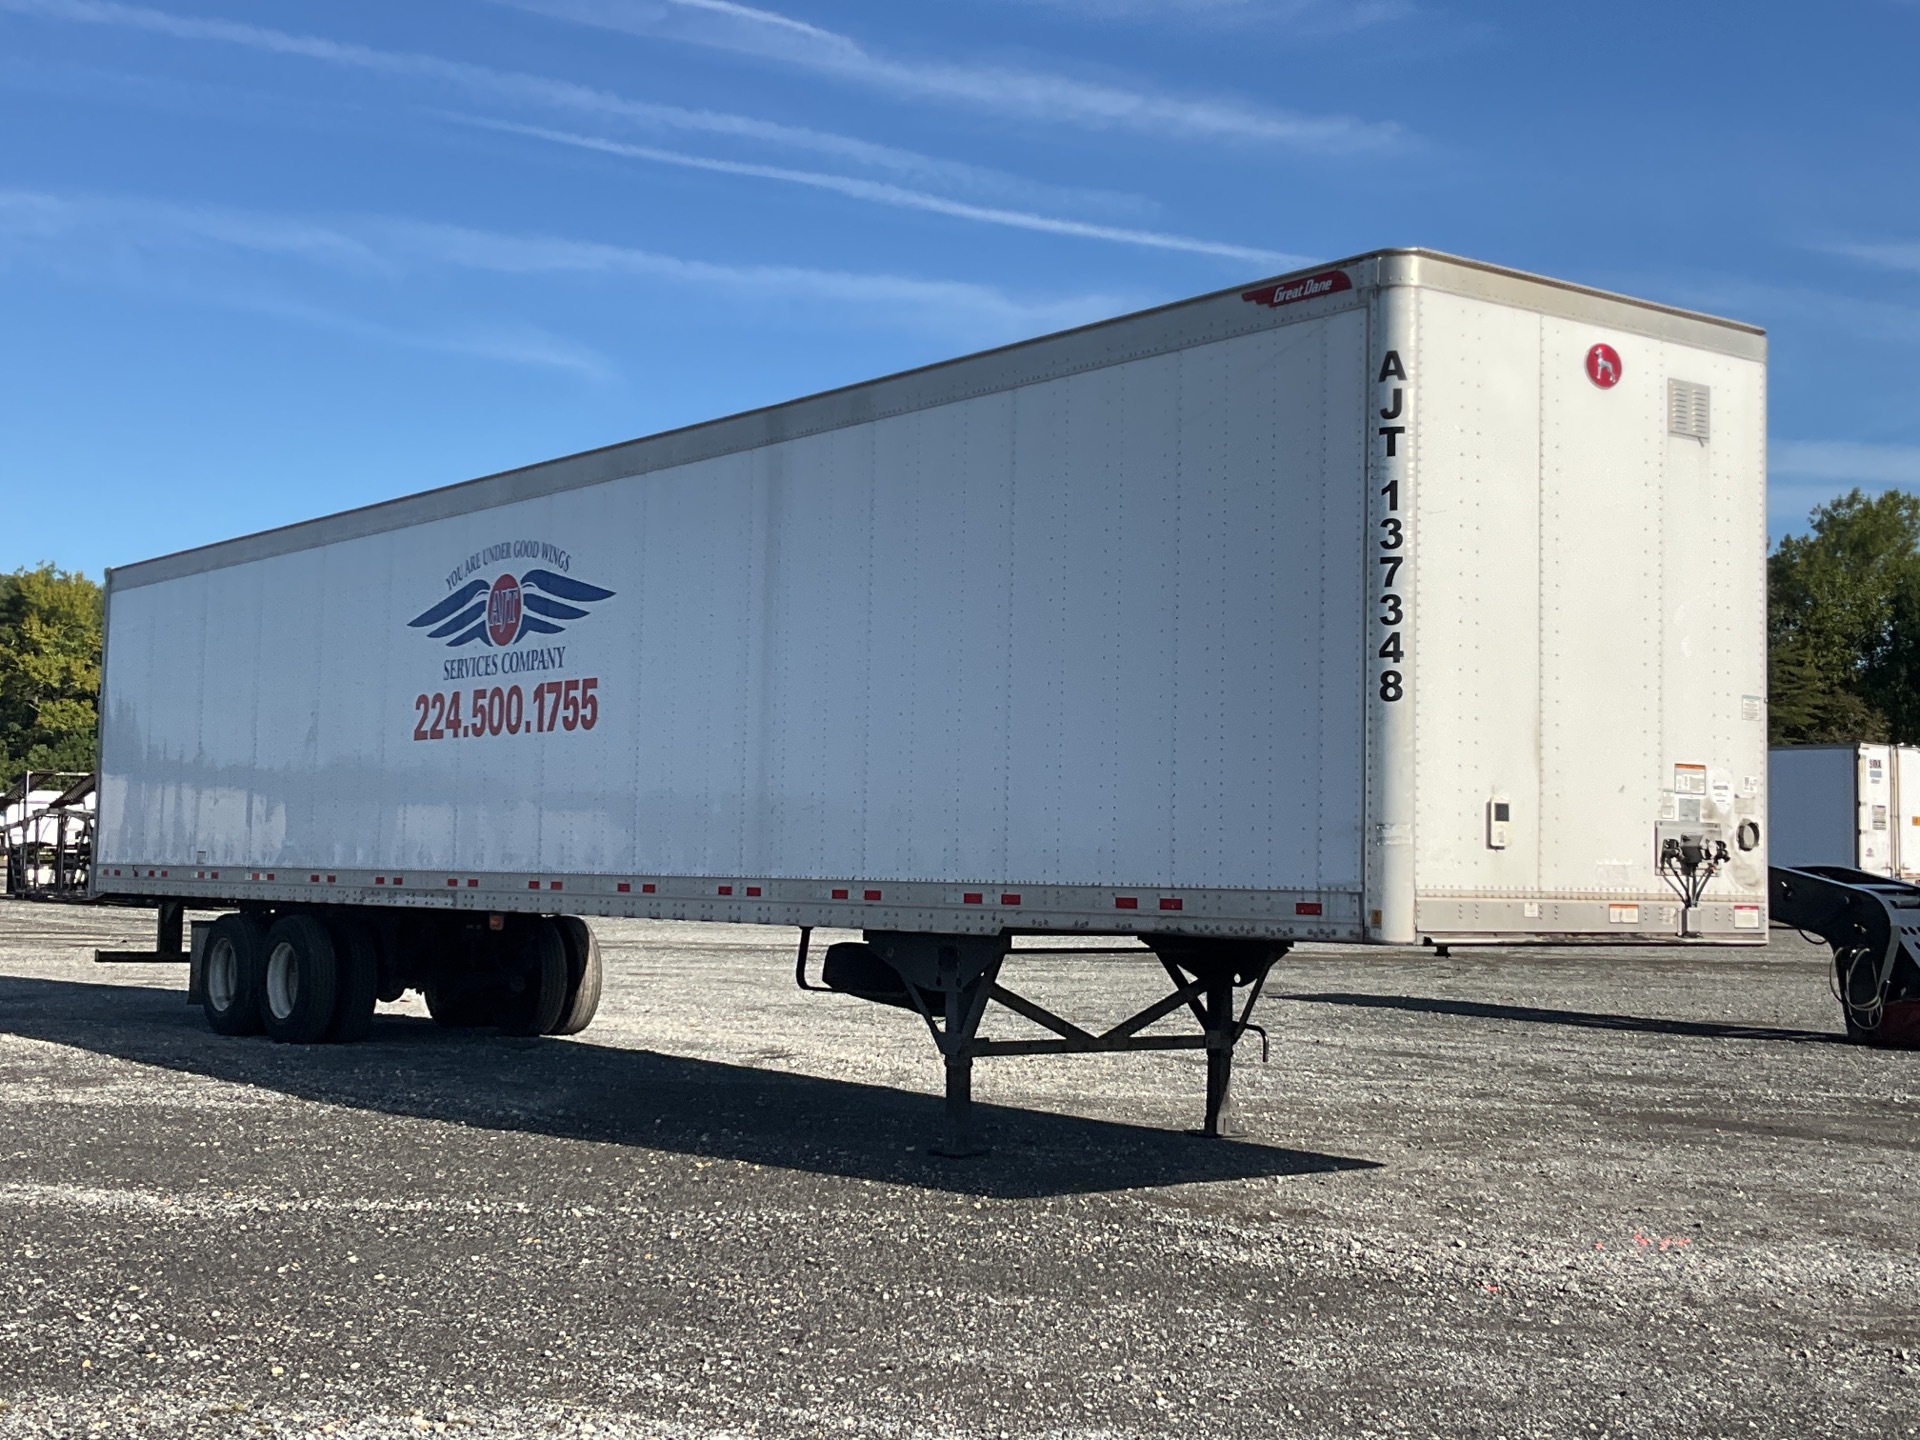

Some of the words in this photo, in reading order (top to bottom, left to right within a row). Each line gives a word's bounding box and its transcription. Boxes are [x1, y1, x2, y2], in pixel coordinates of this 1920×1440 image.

[1273, 286, 1303, 303] Great
[1303, 278, 1332, 295] Dane
[1378, 350, 1407, 457] AJT
[445, 566, 464, 591] YOU
[465, 552, 481, 577] ARE
[483, 541, 512, 566] UNDER
[513, 540, 540, 558] GOOD
[541, 542, 572, 573] WINGS
[1379, 480, 1404, 702] 137348
[489, 588, 519, 632] AJT
[443, 653, 498, 681] SERVICES
[501, 646, 566, 675] COMPANY
[413, 677, 598, 741] 224.500.1755
